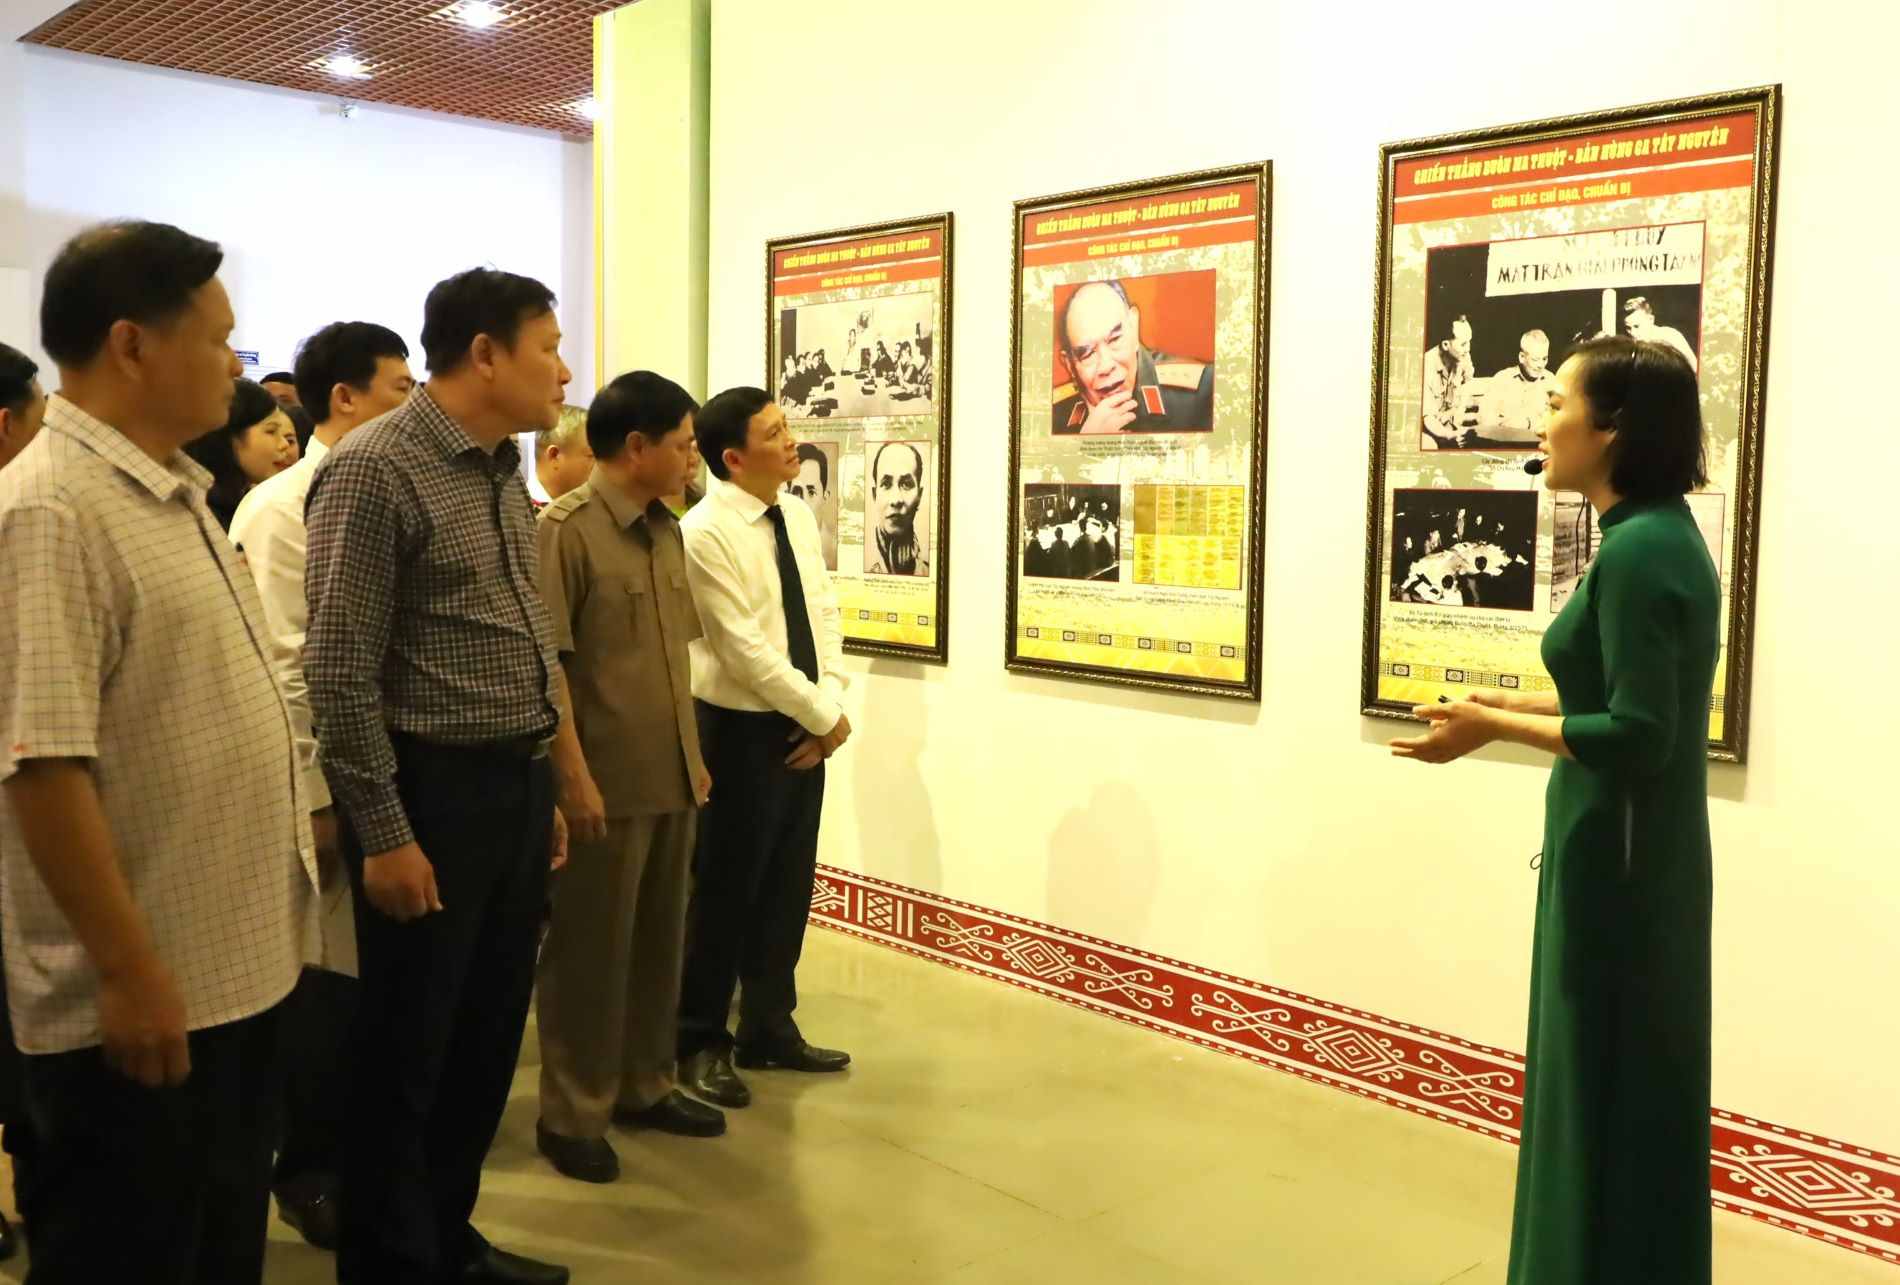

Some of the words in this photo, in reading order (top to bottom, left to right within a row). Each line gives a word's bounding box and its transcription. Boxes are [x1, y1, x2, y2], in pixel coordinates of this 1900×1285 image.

[1414, 162, 1446, 185] CHIẾN
[1531, 147, 1567, 170] THUỘT
[1634, 138, 1650, 156] CA
[1652, 132, 1675, 154] TÂY
[1677, 125, 1729, 150] NGUYÊN
[1492, 192, 1518, 209] CÔNG
